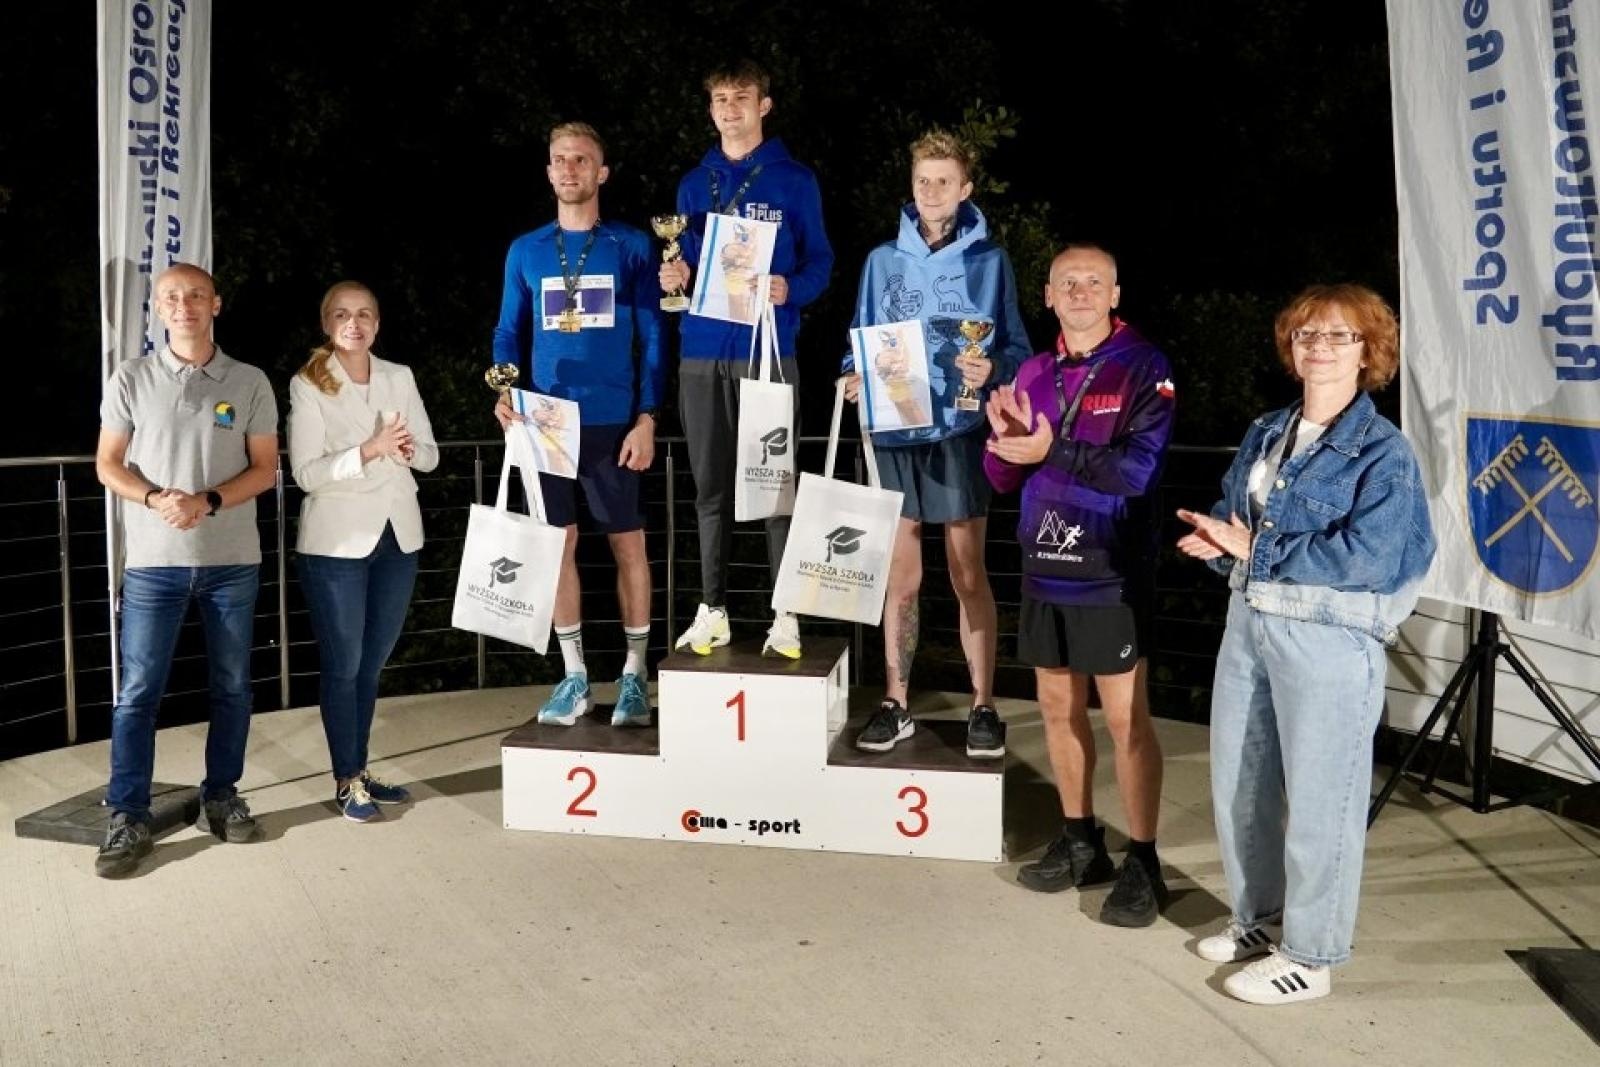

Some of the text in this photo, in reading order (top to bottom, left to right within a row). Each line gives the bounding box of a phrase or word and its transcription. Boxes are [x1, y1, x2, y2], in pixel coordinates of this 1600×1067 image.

[128, 0, 159, 105] Ośro
[758, 209, 783, 221] PLUS
[725, 690, 746, 742] 1
[566, 766, 598, 818] 2
[895, 785, 929, 837] 3
[748, 819, 801, 836] sport
